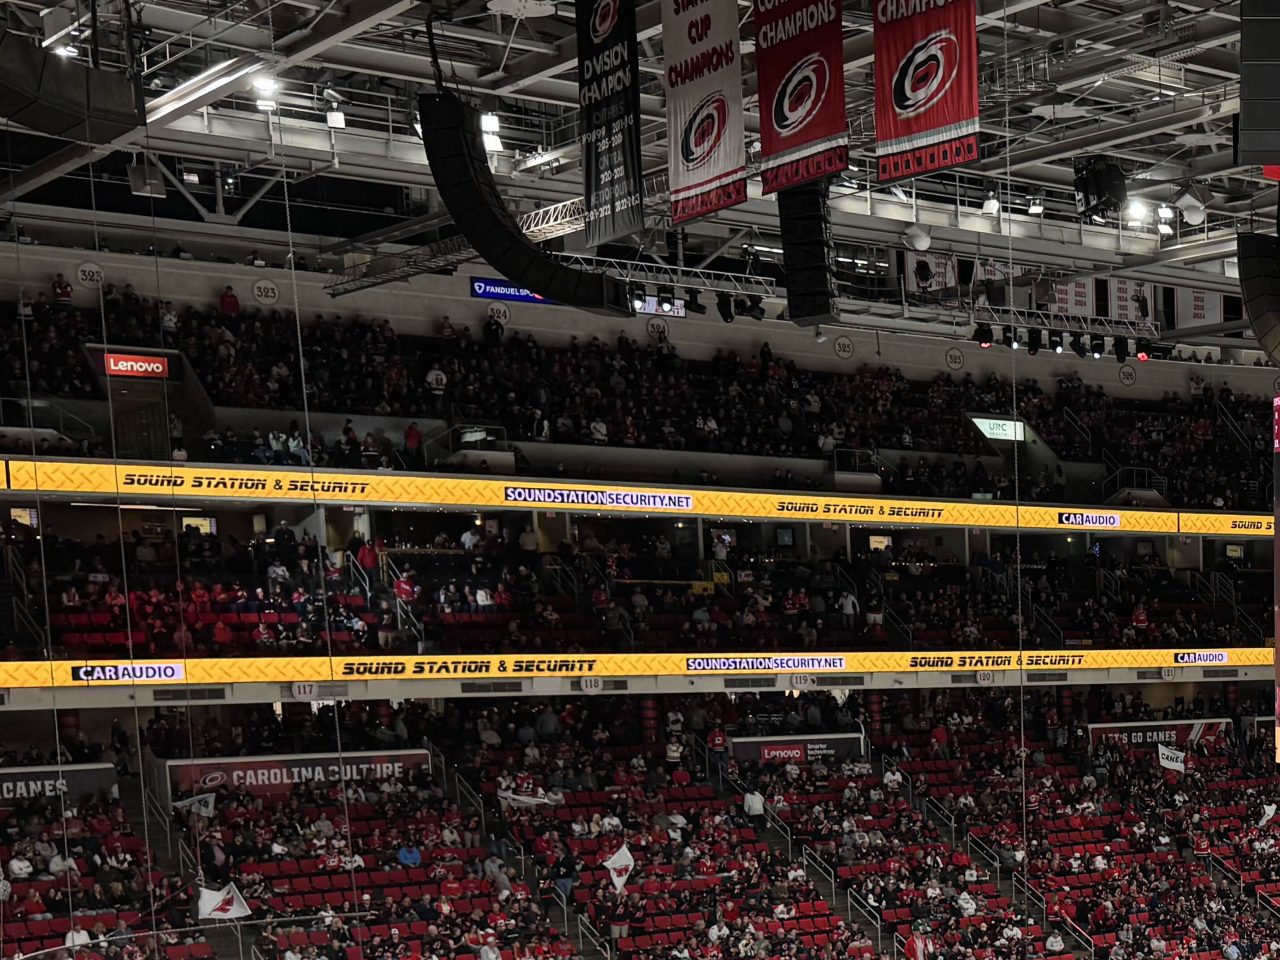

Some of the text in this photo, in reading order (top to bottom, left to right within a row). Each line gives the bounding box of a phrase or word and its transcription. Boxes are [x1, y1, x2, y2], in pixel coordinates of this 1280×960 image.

[688, 14, 711, 45] CUP
[758, 1, 836, 49] CHAMPIONS
[668, 39, 735, 88] CHAMPIONS
[256, 286, 276, 298] 323
[486, 286, 519, 295] FANDUEL
[109, 359, 162, 373] Lenovo
[123, 474, 369, 494] SOUND STATION & SECURITY
[507, 487, 692, 508] SOUNDSTATIONSECURITY.NET
[777, 502, 945, 518] SOUND STATION & SECURITY
[1231, 521, 1263, 529] SOUND
[342, 660, 597, 675] SOUND STATION & SECURITY
[687, 657, 845, 669] SOUNDSTATIONSECURITY.NET
[909, 655, 1085, 667] SOUND STATION & SECURITY
[297, 684, 314, 695] 117
[584, 678, 599, 688] 118
[1132, 731, 1176, 743] GO CANES
[765, 749, 800, 760] Lenovo
[233, 766, 324, 786] CAROLINA
[3, 779, 67, 798] CANES
